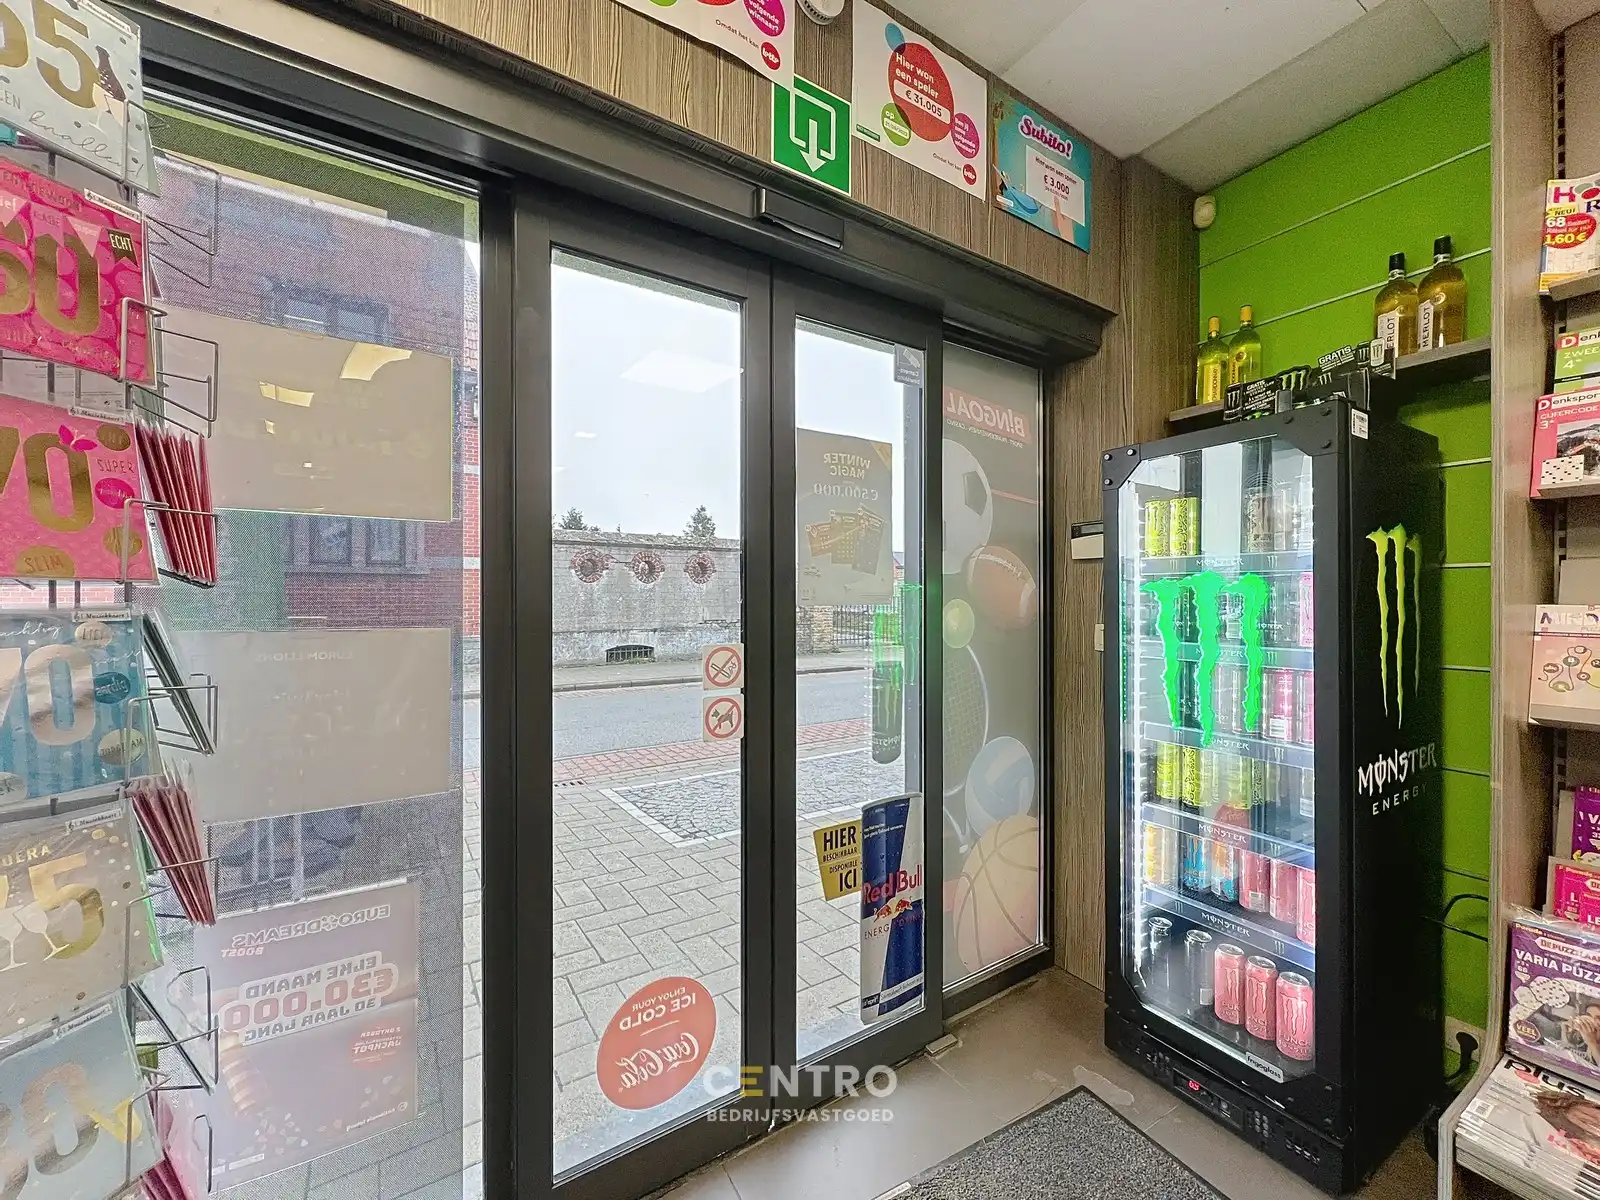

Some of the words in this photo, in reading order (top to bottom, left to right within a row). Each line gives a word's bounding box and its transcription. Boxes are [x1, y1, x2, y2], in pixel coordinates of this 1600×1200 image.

[895, 52, 914, 72] Hier
[915, 66, 934, 84] won
[895, 68, 912, 83] een
[914, 78, 939, 99] speler
[885, 110, 895, 120] op
[905, 89, 912, 101] €
[914, 92, 942, 117] 31.005
[1019, 116, 1073, 159] Subito!
[1049, 177, 1070, 195] 3.000
[1546, 216, 1567, 228] 68
[109, 232, 132, 252] ECHT
[1575, 231, 1588, 242] €
[1386, 317, 1395, 350] ERLOT
[1422, 306, 1431, 348] MERLOT
[1318, 345, 1352, 364] GRATIS
[96, 458, 135, 474] SUPER
[1371, 781, 1429, 816] ENERGY
[823, 825, 857, 852] HIER
[822, 847, 858, 863] BESCHIKBAAR
[829, 860, 858, 874] DISPONIBLE
[839, 868, 857, 893] ICI
[863, 872, 894, 905] Red
[896, 863, 923, 893] Bull
[1514, 948, 1559, 971] VARIA
[1504, 1059, 1587, 1100] plus
